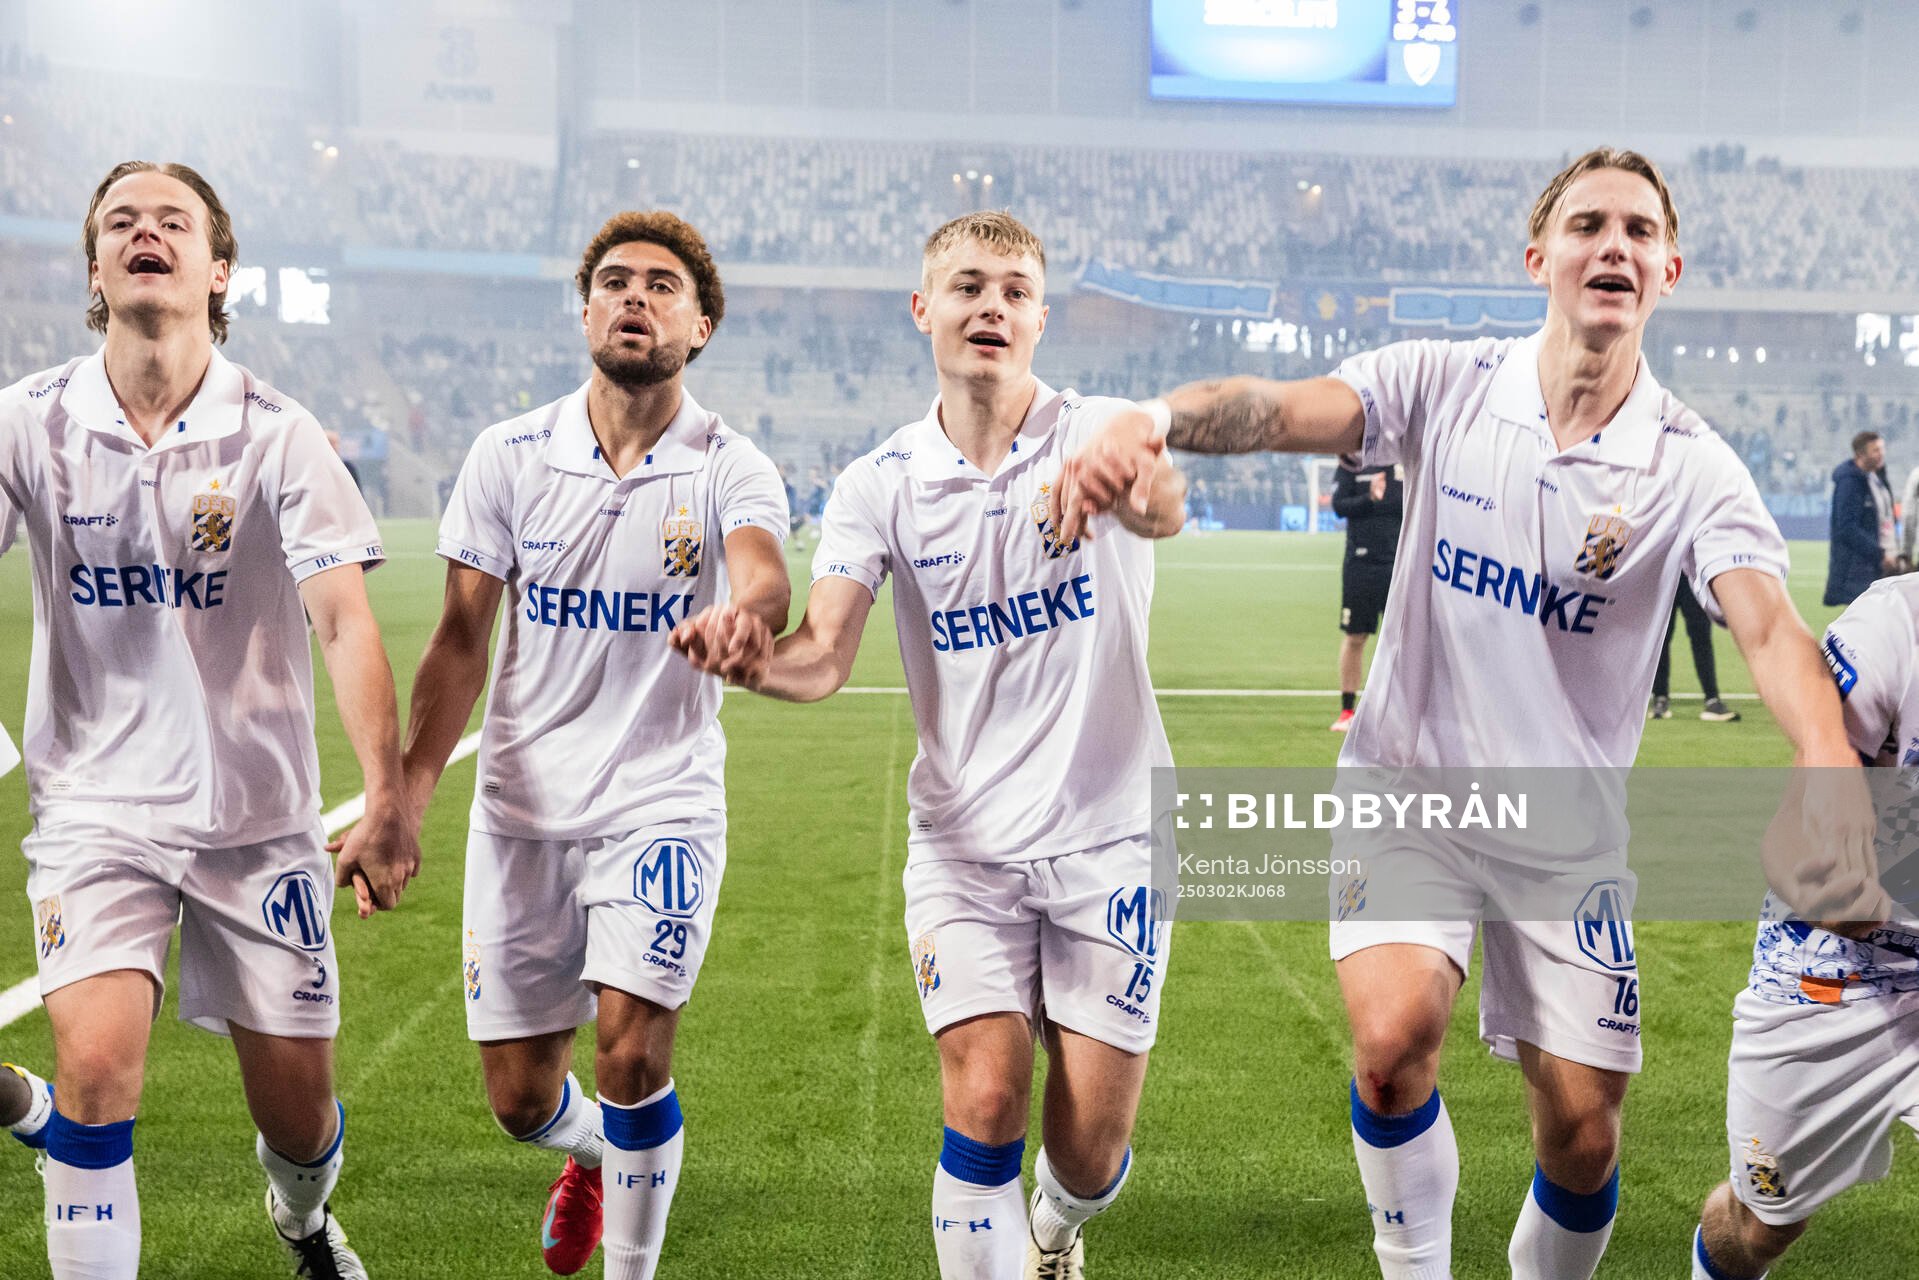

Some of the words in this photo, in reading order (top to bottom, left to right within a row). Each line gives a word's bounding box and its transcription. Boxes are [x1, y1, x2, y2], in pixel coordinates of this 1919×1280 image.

[505, 429, 551, 447] FAMECO
[1442, 485, 1484, 506] CRAFT
[63, 515, 105, 527] CRAFT
[522, 540, 557, 552] CRAFT
[316, 553, 342, 569] IFK
[460, 549, 484, 567] IFK
[913, 553, 952, 569] CRAFT
[1432, 538, 1607, 634] SERNKE
[931, 573, 1095, 652] SERNEKE
[650, 919, 688, 960] 29
[642, 952, 681, 971] CRAFT
[1124, 962, 1154, 1004] 15
[292, 990, 330, 1004] CRAFT
[1613, 976, 1638, 1017] 16
[1106, 994, 1145, 1019] CRAFT
[1597, 1017, 1637, 1035] CRAFT
